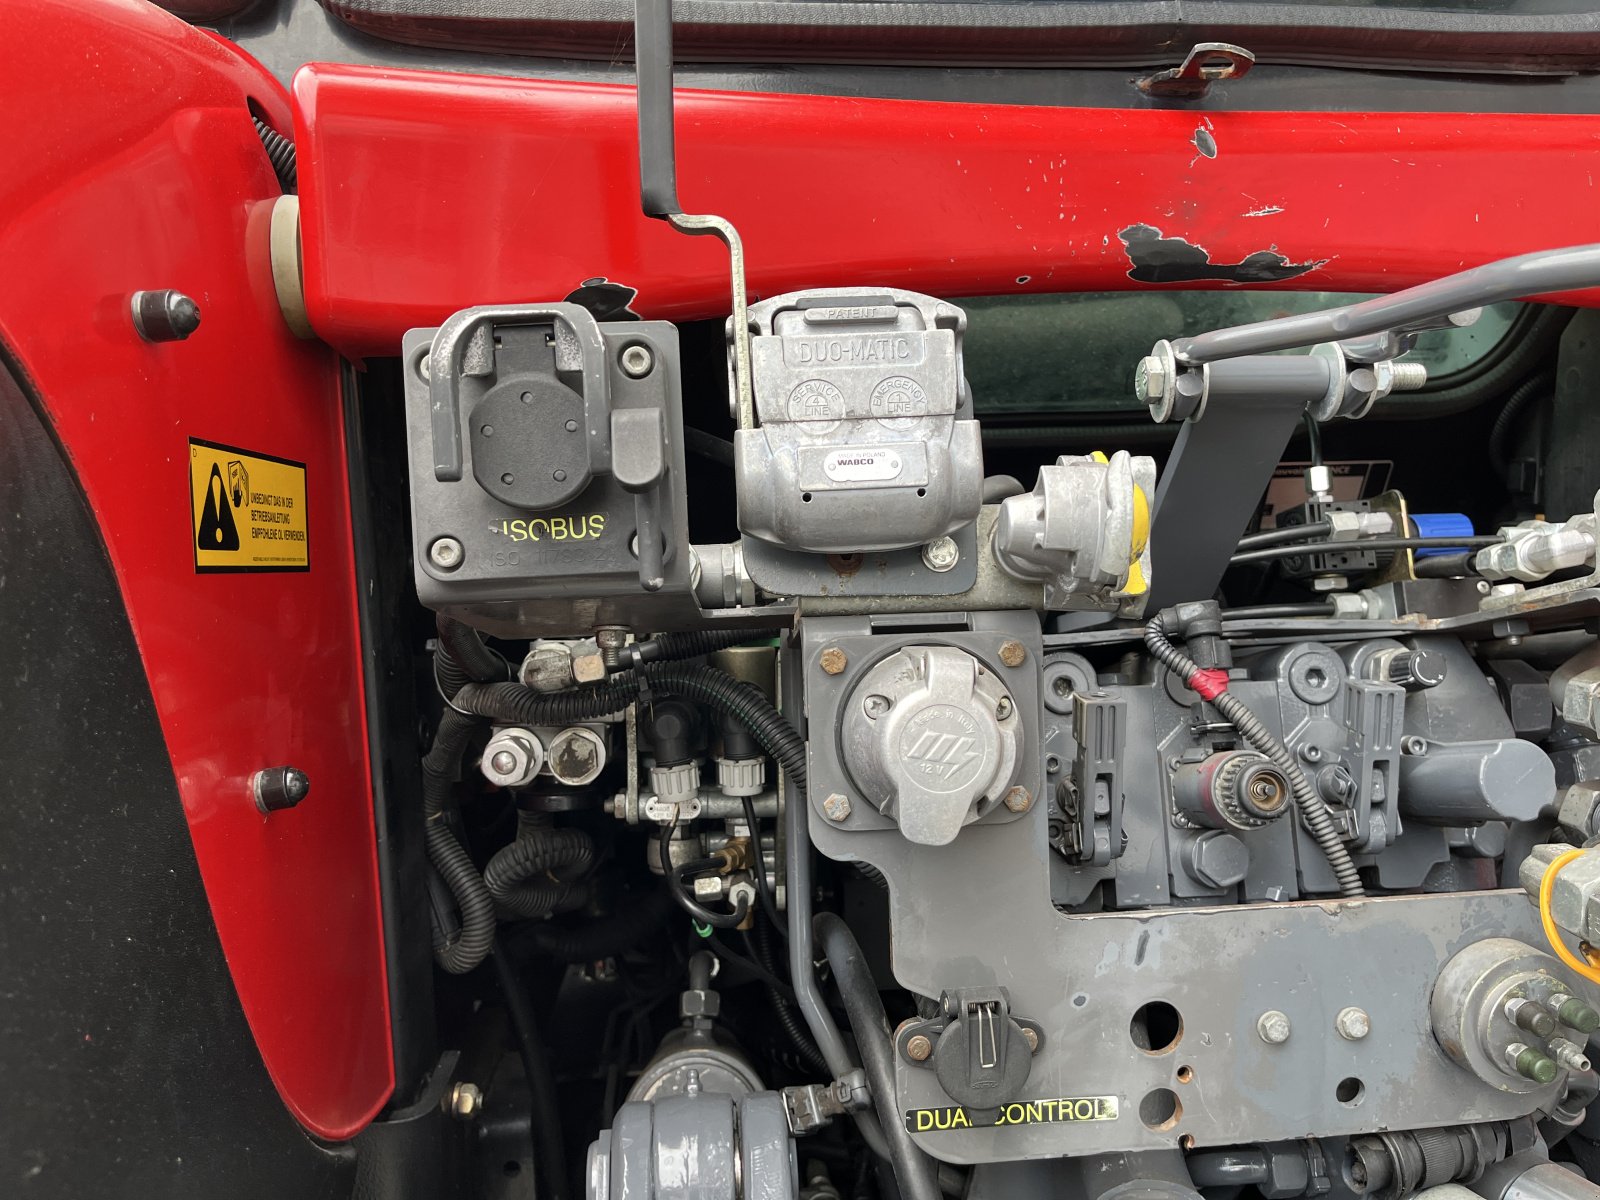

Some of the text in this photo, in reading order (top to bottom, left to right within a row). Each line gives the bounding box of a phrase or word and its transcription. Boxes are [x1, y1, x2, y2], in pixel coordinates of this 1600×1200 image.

[828, 308, 877, 319] PATENT
[800, 338, 910, 363] DUO-MATIC
[792, 382, 841, 404] SERVICE
[812, 397, 821, 406] 4
[872, 379, 926, 407] EMERGENCY
[804, 406, 830, 417] LINE
[887, 403, 912, 414] LINE
[837, 458, 874, 466] WABCO
[503, 514, 605, 542] ISOBUS
[958, 714, 976, 734] Italy
[917, 1107, 973, 1132] DUA
